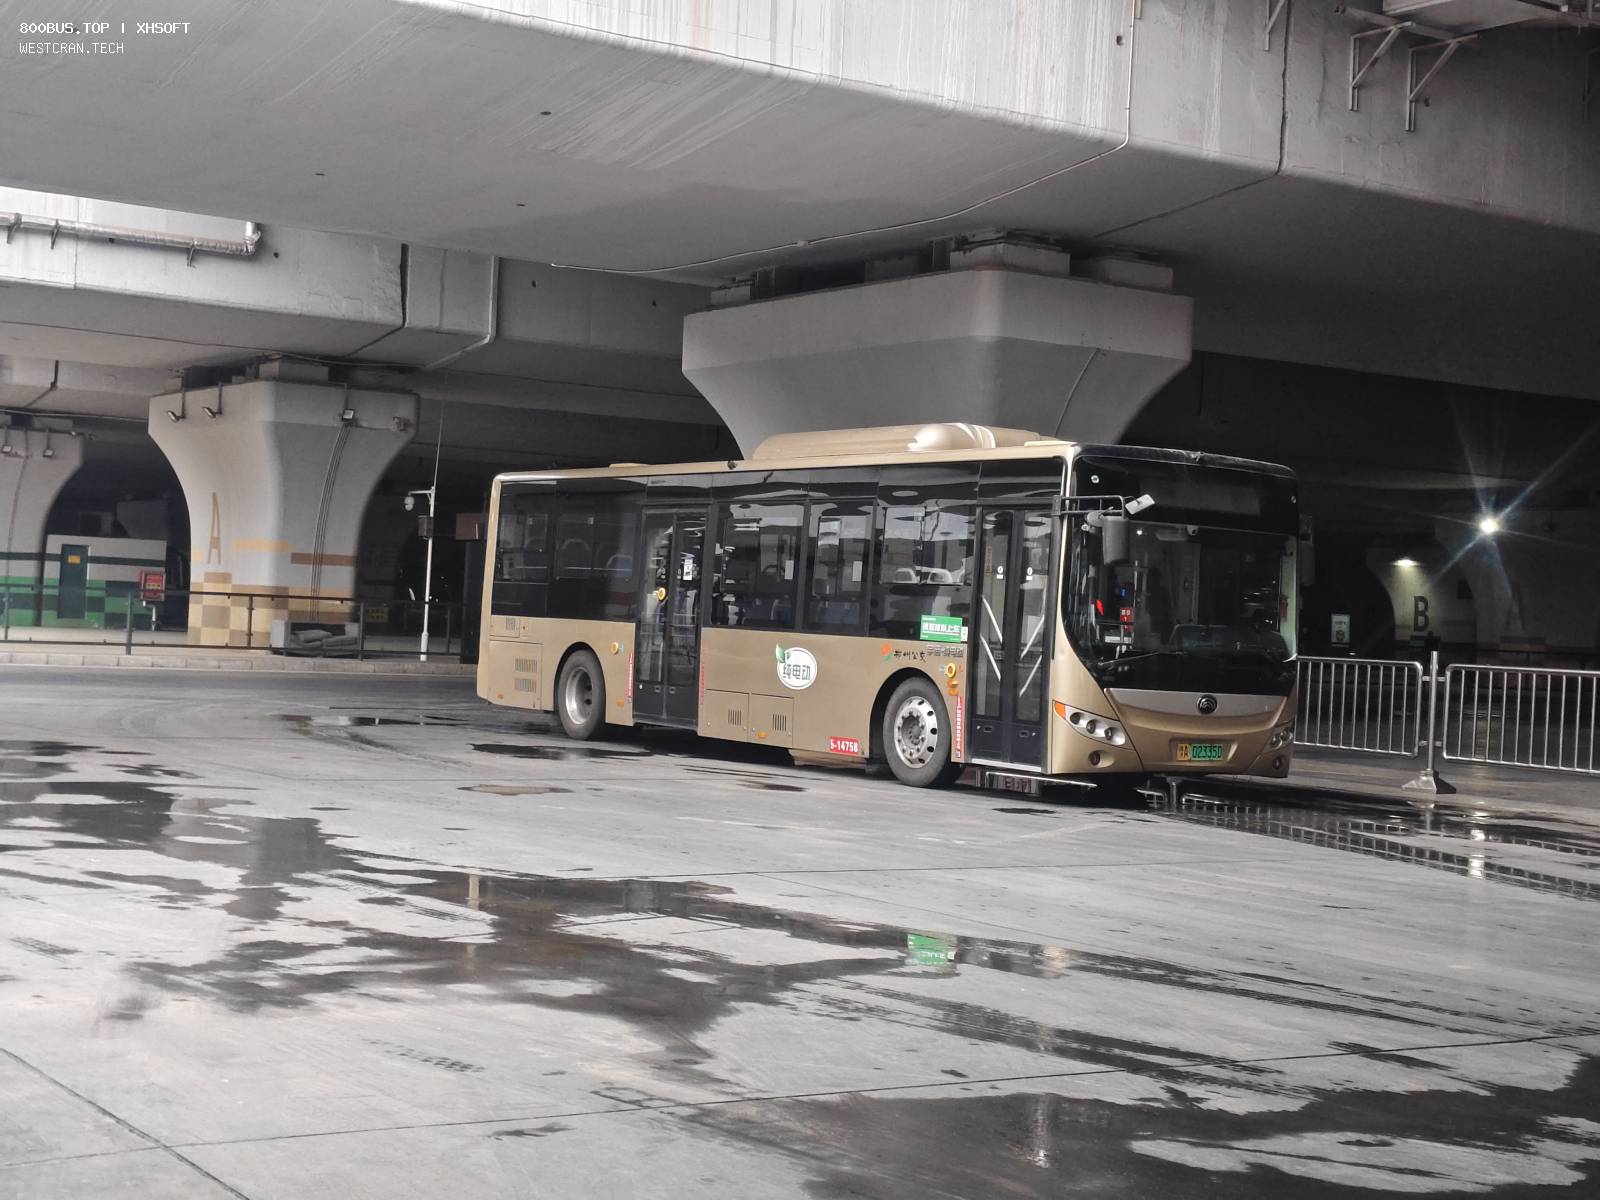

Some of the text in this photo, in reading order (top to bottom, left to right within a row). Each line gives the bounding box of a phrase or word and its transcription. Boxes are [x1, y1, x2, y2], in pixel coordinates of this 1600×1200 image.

[1413, 595, 1430, 633] B
[782, 663, 811, 681] 纯电动
